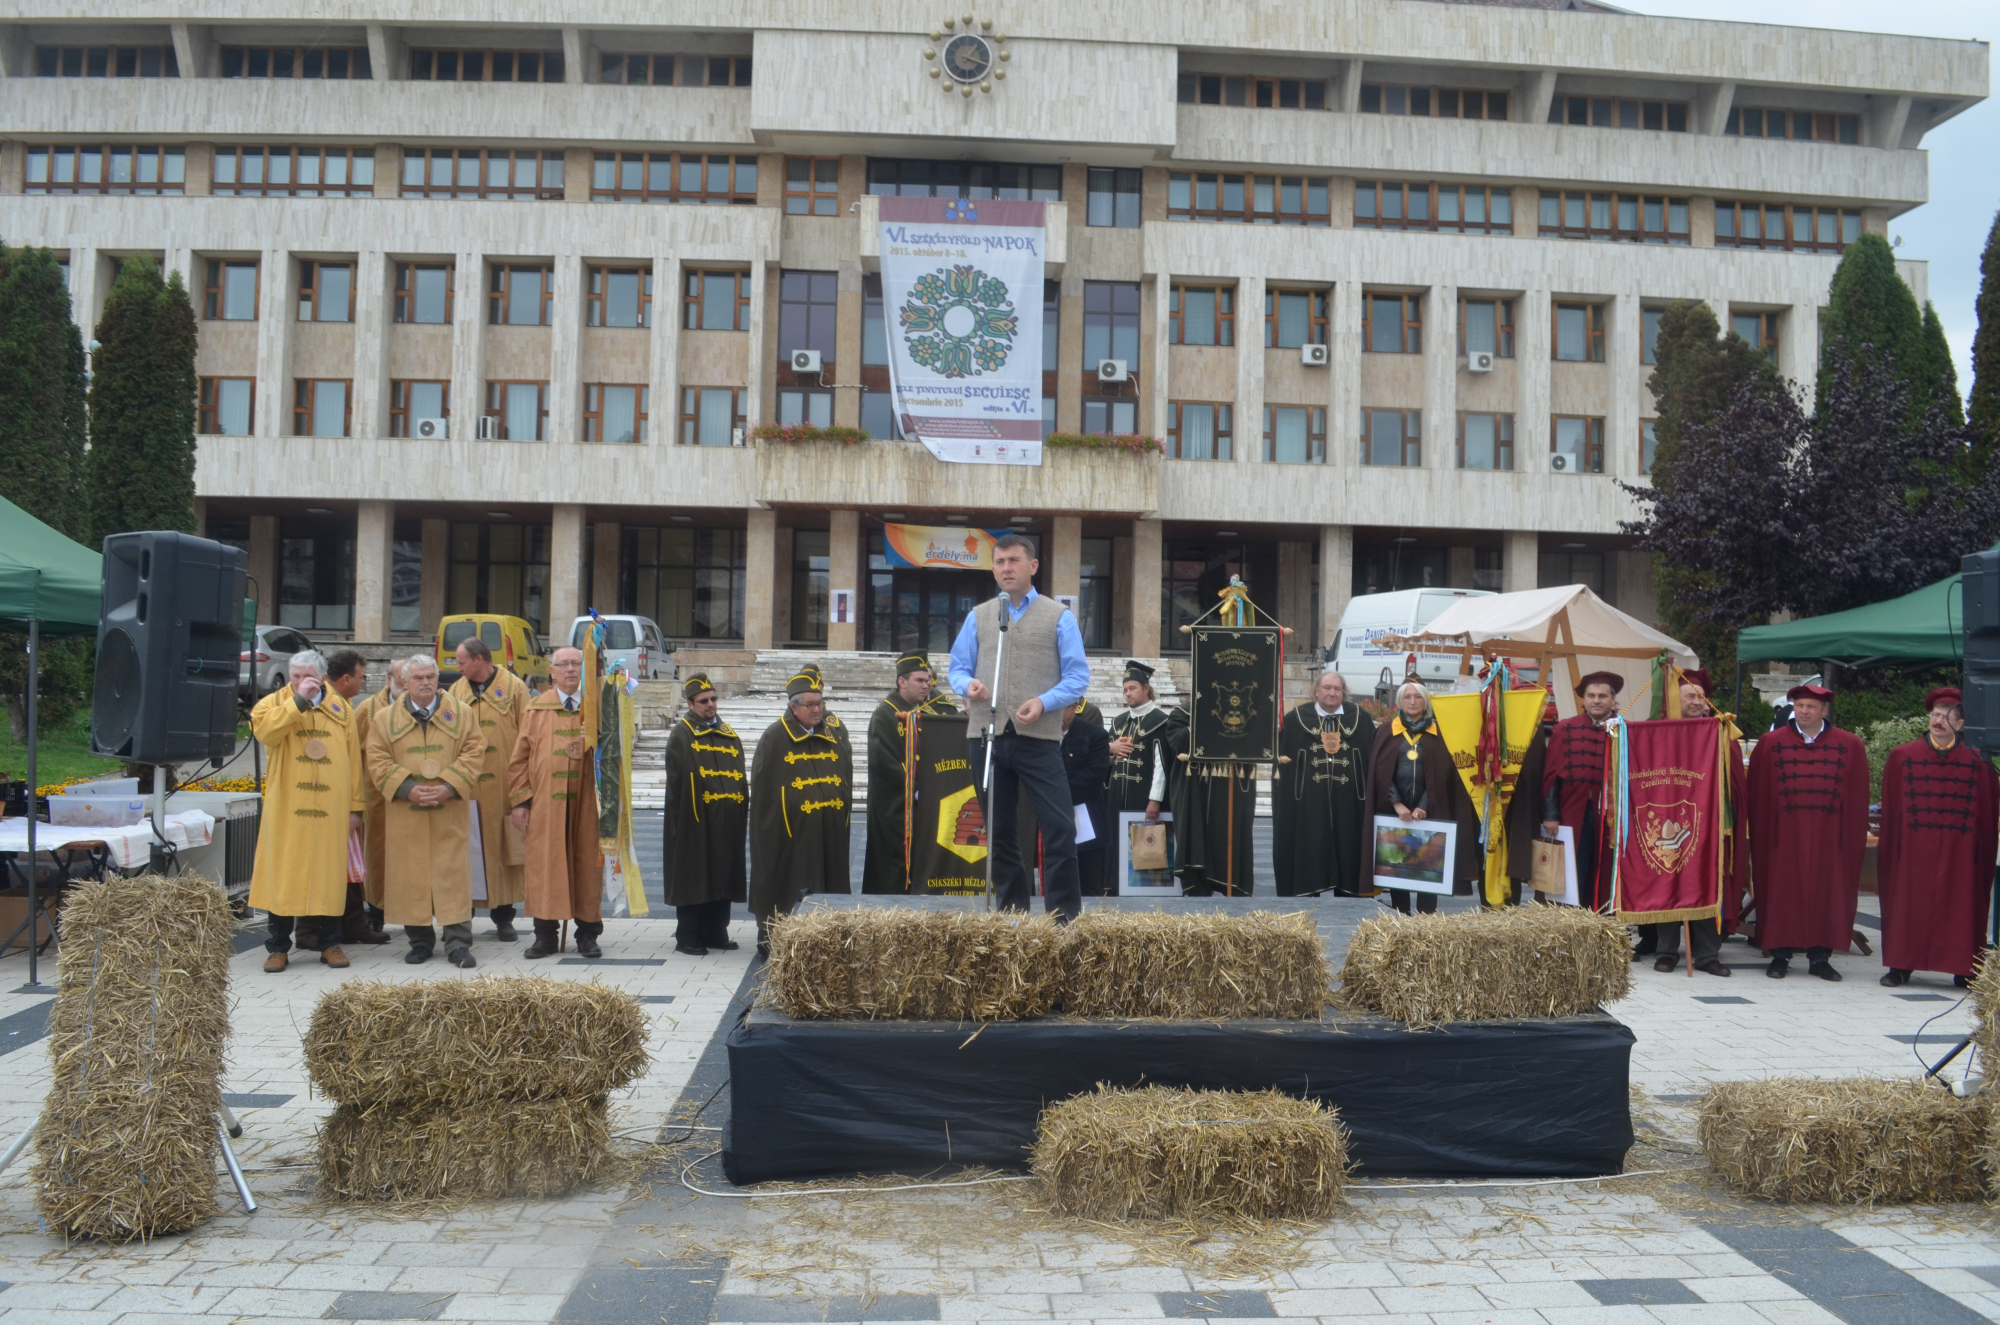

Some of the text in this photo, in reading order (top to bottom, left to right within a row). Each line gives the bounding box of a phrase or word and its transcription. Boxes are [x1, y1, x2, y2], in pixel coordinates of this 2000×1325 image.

[886, 226, 909, 244] VI.
[983, 236, 1038, 257] NAPOK
[944, 399, 964, 408] 2015
[926, 550, 978, 562] erdely.ma
[934, 759, 967, 773] MÉZBEN
[927, 876, 994, 889] CSÍKSZÉKI MÉZLOA
